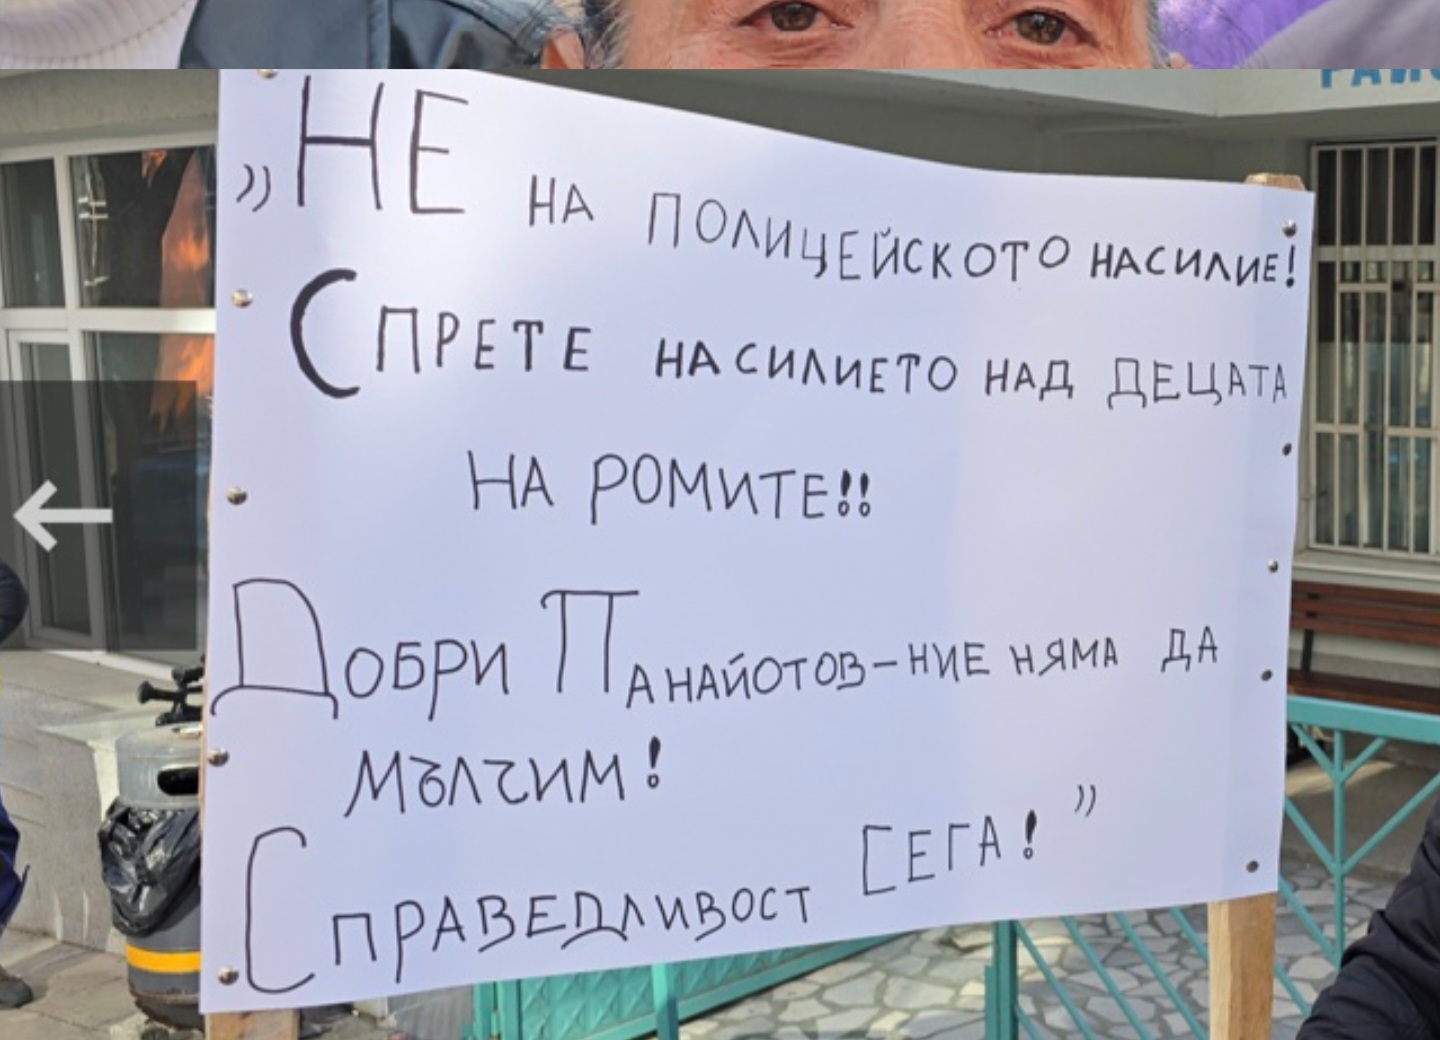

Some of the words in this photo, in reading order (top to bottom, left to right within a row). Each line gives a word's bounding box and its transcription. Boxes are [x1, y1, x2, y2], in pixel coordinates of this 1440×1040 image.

[528, 174, 595, 227] НА
[648, 192, 1070, 282] ПОЛИЦЕЙСКОТО
[1090, 243, 1296, 288] НАСИЛИЕ!
[654, 337, 958, 394] НАСИЛИЕТО
[984, 358, 1075, 401] НАД
[1107, 357, 1288, 410] ДЕЦАТА
[467, 449, 554, 510] НА
[590, 453, 871, 525] РОМИТЕ!!
[1010, 637, 1119, 677] НЯМА
[1159, 625, 1219, 673] ДА
